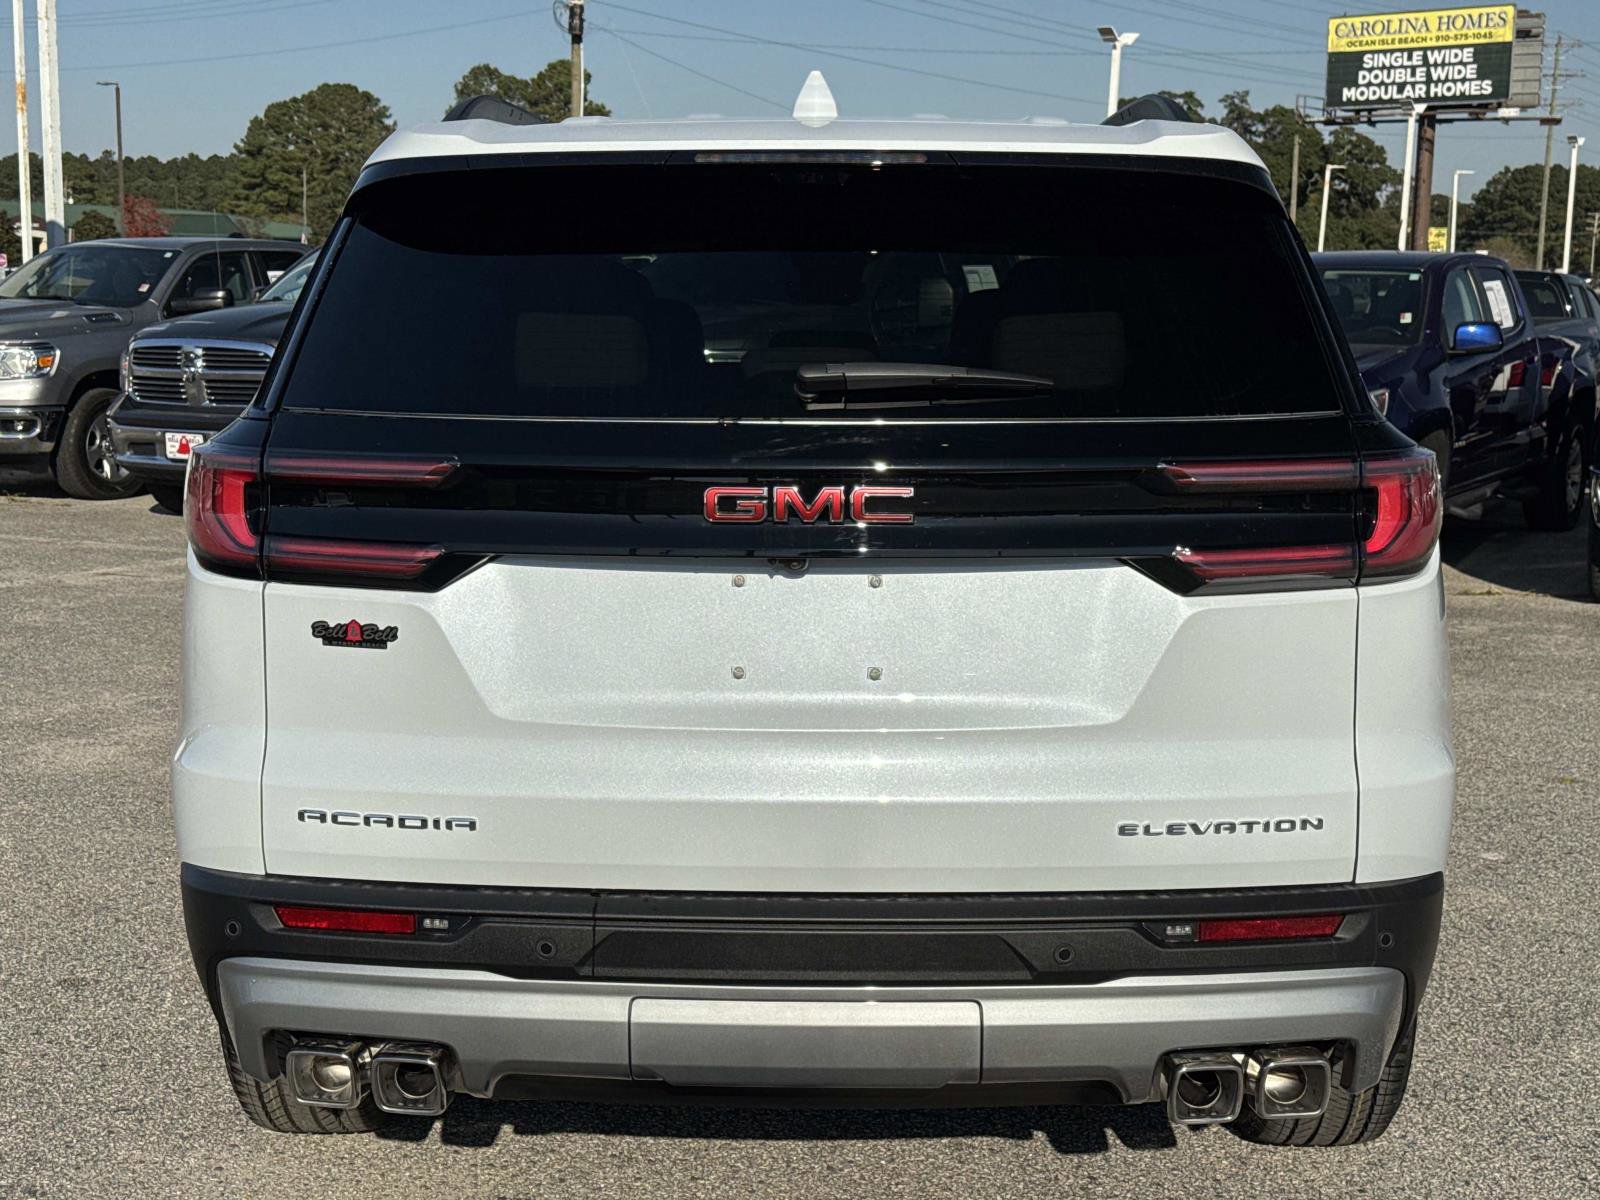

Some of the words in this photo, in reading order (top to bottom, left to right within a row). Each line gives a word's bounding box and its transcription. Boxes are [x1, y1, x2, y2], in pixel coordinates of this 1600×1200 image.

[1335, 17, 1430, 39] CAROLINA
[1437, 11, 1507, 31] HOMES
[1346, 39, 1376, 48] OCEAN
[1377, 37, 1396, 46] ISLE
[1398, 36, 1427, 45] BEACH
[1362, 52, 1424, 69] SINGLE
[1427, 48, 1474, 65] WIDE
[1357, 68, 1427, 85] DOUBLE
[1429, 65, 1477, 81] WIDE
[1342, 84, 1426, 102] MODULAR
[1429, 80, 1492, 98] HOMES
[703, 486, 914, 523] GMC
[311, 620, 347, 638] Bell
[362, 623, 398, 642] Bell
[298, 809, 477, 832] ACADIA
[1118, 815, 1324, 837] ELEVATION
